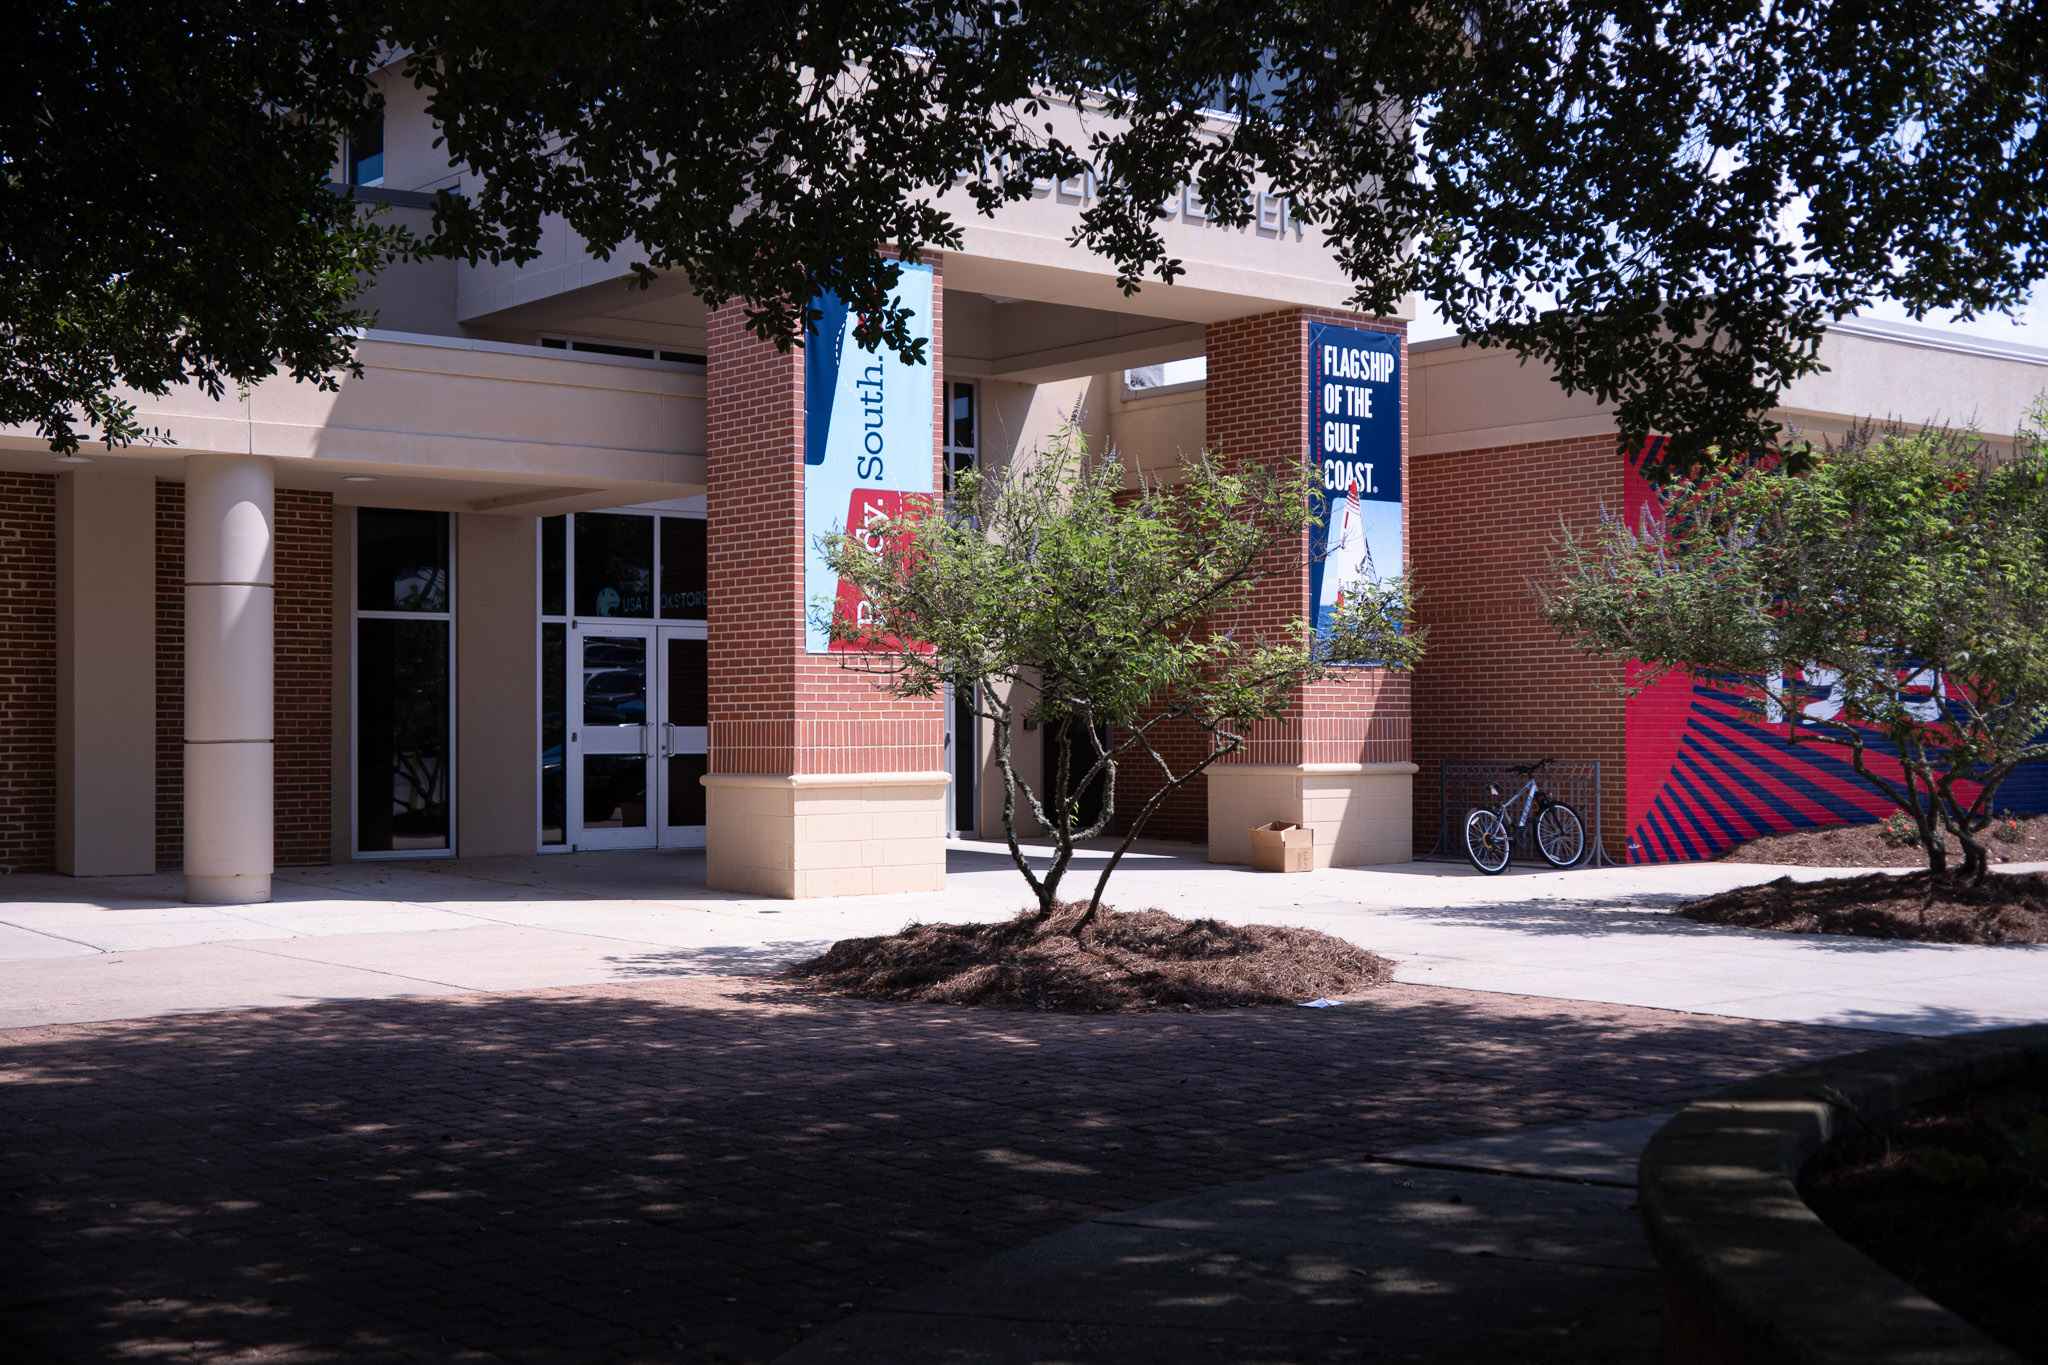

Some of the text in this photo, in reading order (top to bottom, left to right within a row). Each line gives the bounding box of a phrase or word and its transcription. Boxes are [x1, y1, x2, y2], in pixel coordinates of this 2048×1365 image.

[1323, 345, 1396, 384] FLAGSHIP
[855, 355, 885, 480] South.
[1324, 383, 1373, 419] OF THE
[1324, 421, 1361, 455] GULF
